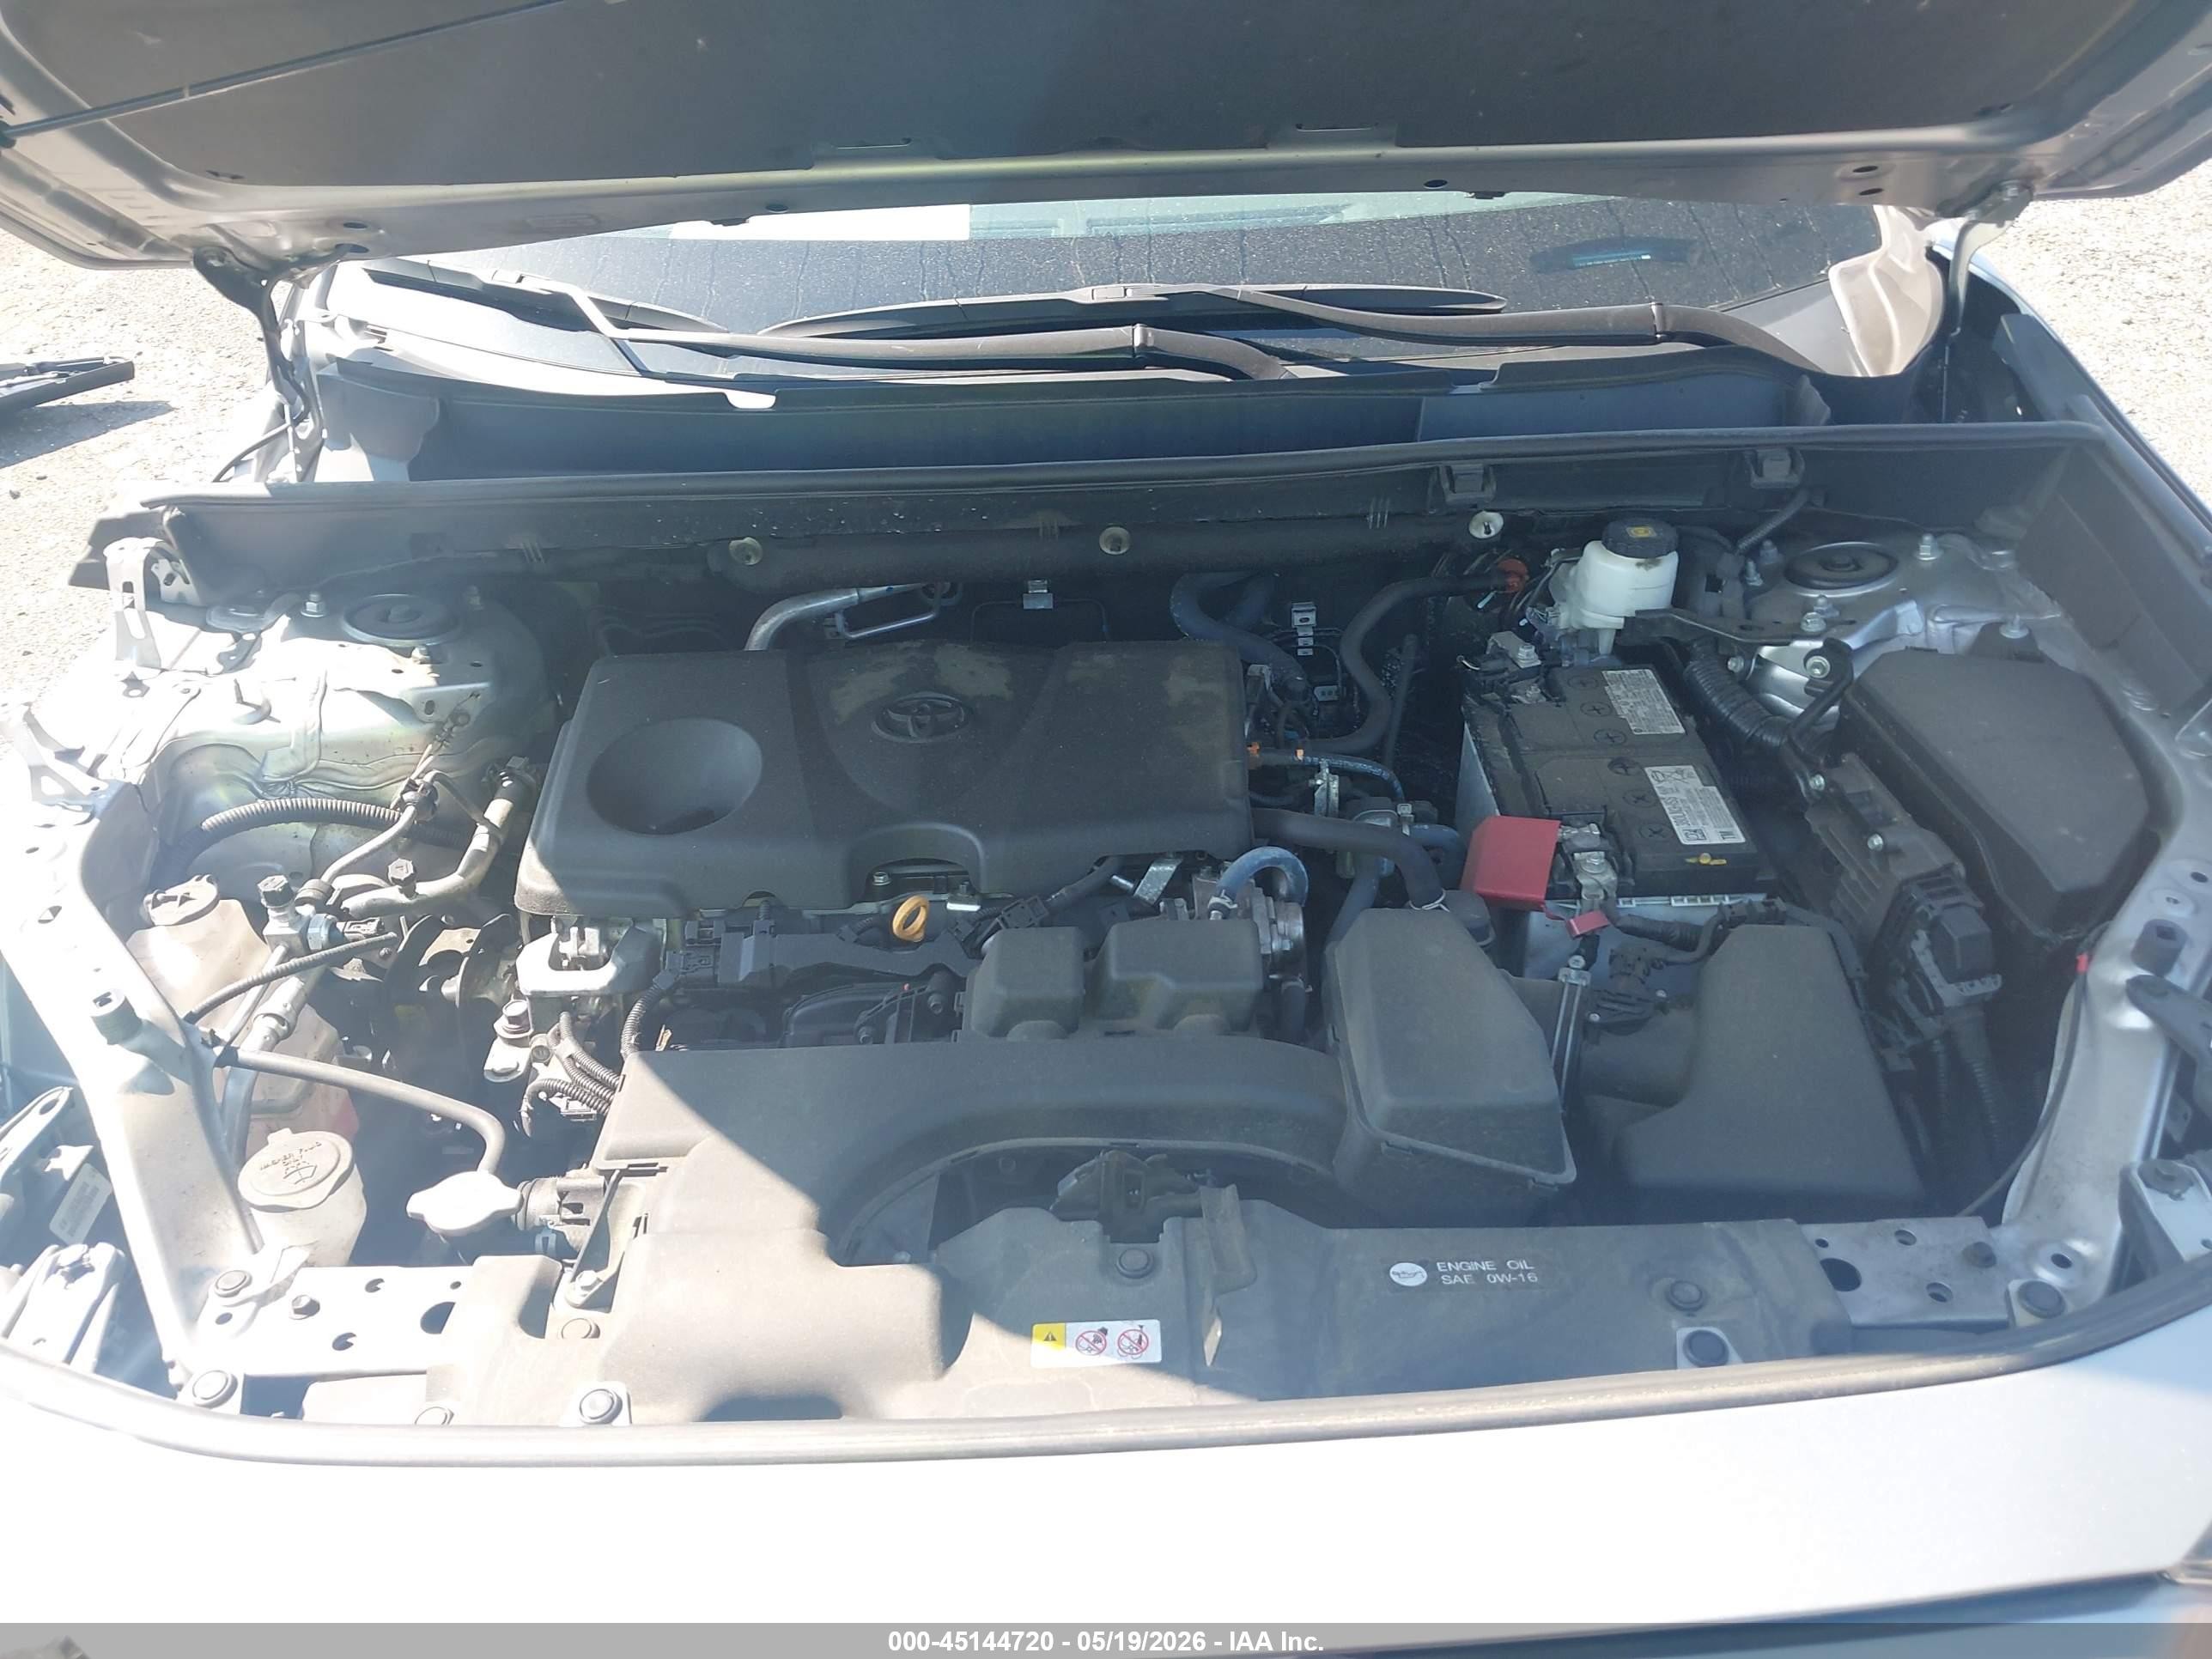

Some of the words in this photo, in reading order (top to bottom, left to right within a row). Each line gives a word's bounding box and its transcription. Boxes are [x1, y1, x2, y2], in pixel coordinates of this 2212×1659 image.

[1437, 1261, 1497, 1272] ENGINE
[1506, 1260, 1535, 1270] OIL
[1441, 1273, 1475, 1285] SAE
